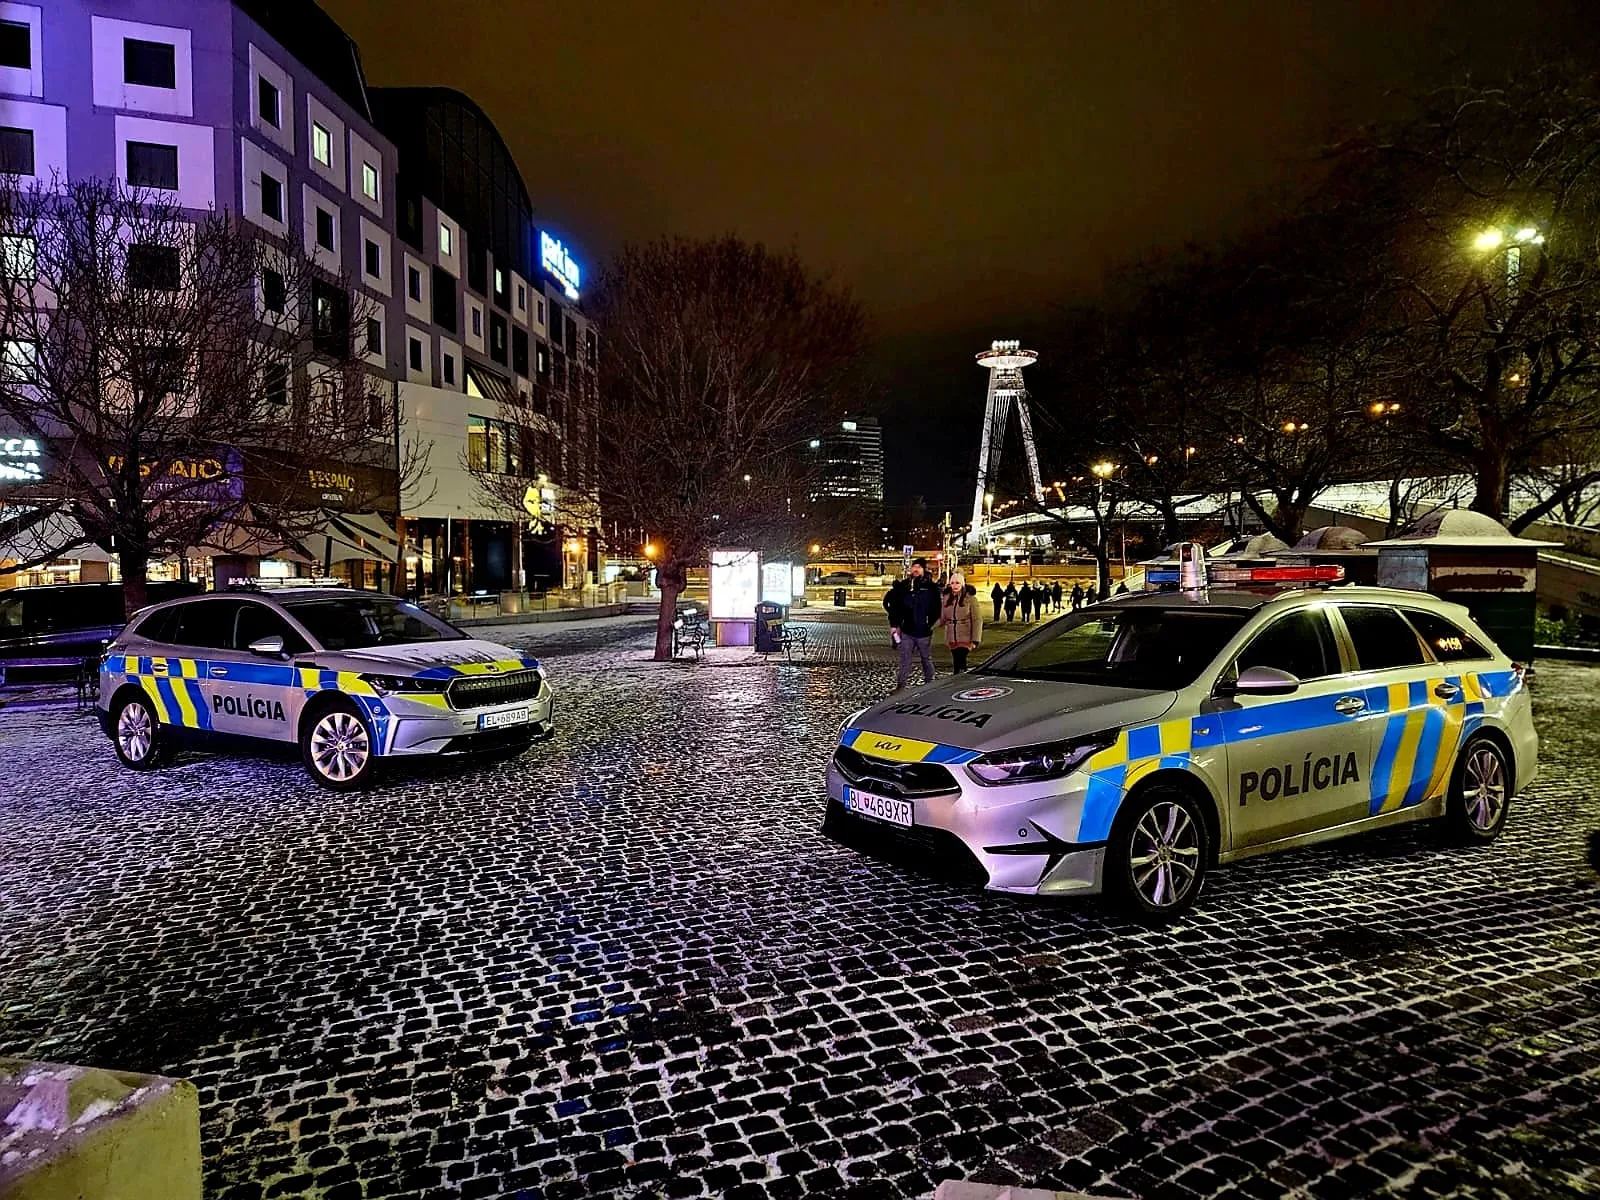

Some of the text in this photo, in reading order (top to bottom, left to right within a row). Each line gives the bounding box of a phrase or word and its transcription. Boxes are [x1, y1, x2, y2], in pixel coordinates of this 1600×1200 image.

[212, 693, 286, 721] POLÍCIA
[879, 703, 993, 729] POLÍCIA
[1239, 751, 1360, 807] POLÍCIA
